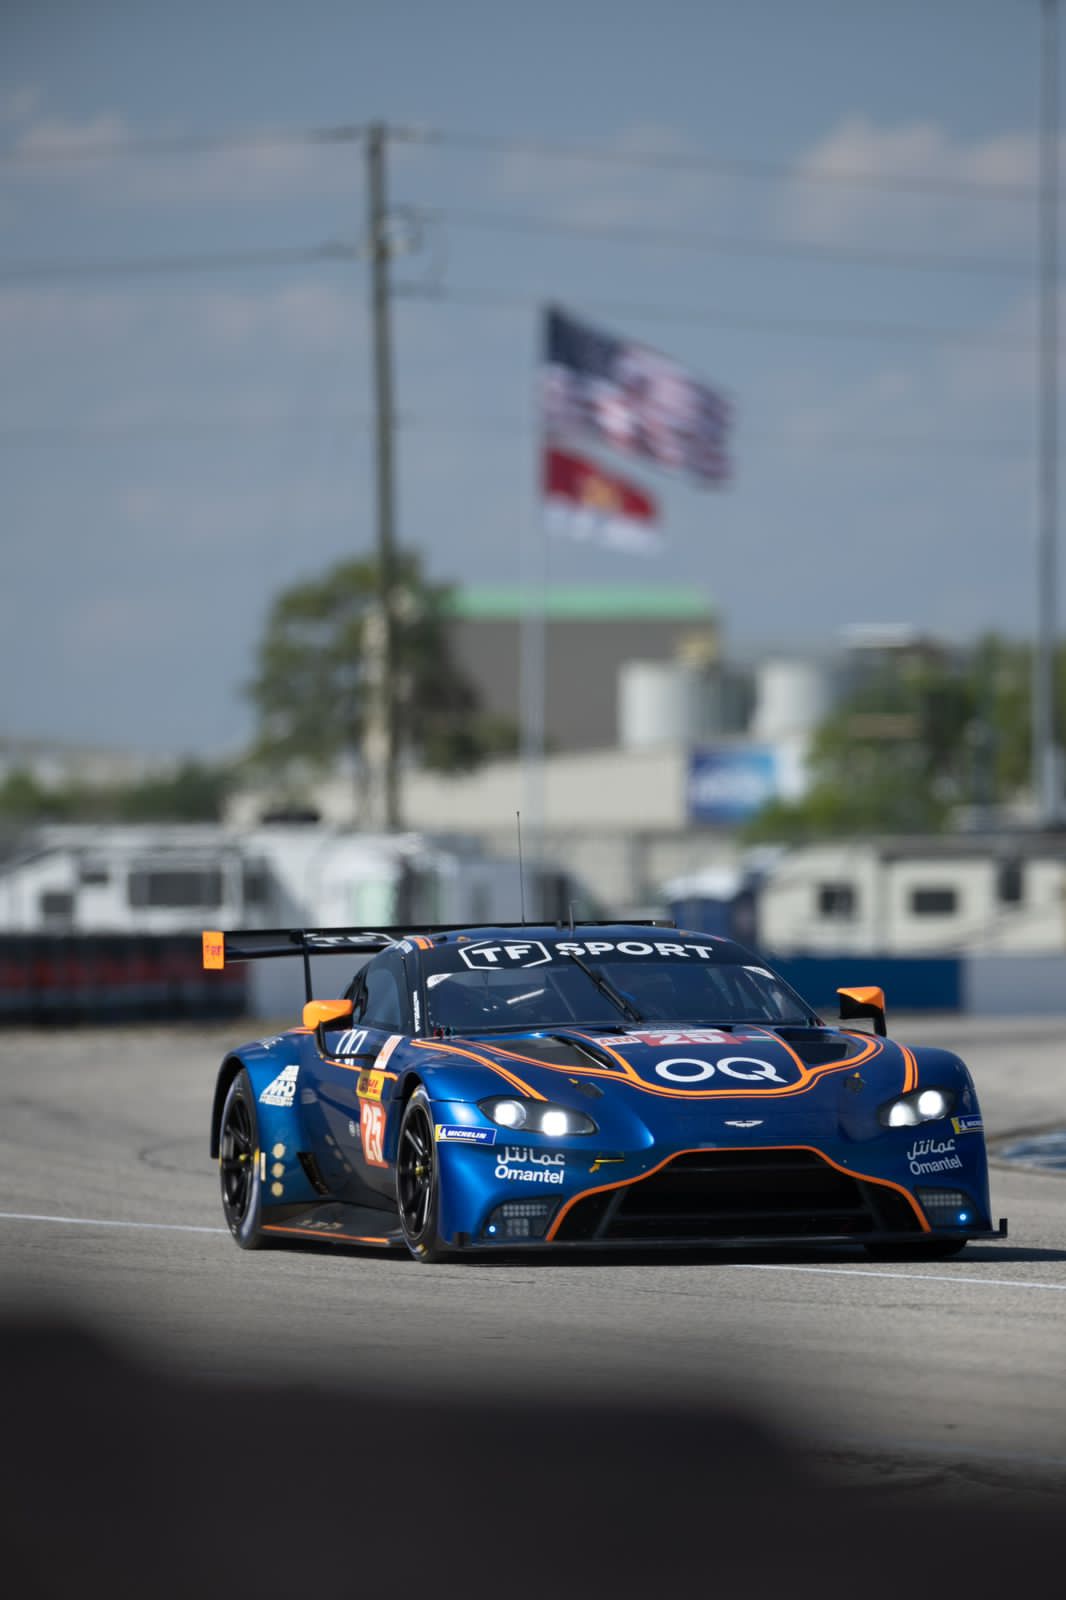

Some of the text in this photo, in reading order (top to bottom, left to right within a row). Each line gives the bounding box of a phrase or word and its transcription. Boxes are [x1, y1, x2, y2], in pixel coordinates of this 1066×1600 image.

[471, 942, 713, 962] TF SPORT
[655, 1057, 789, 1083] OQ
[362, 1103, 384, 1163] 25
[446, 1130, 488, 1139] MICHELIN
[494, 1165, 564, 1184] Omantel
[909, 1154, 963, 1175] Omantel
